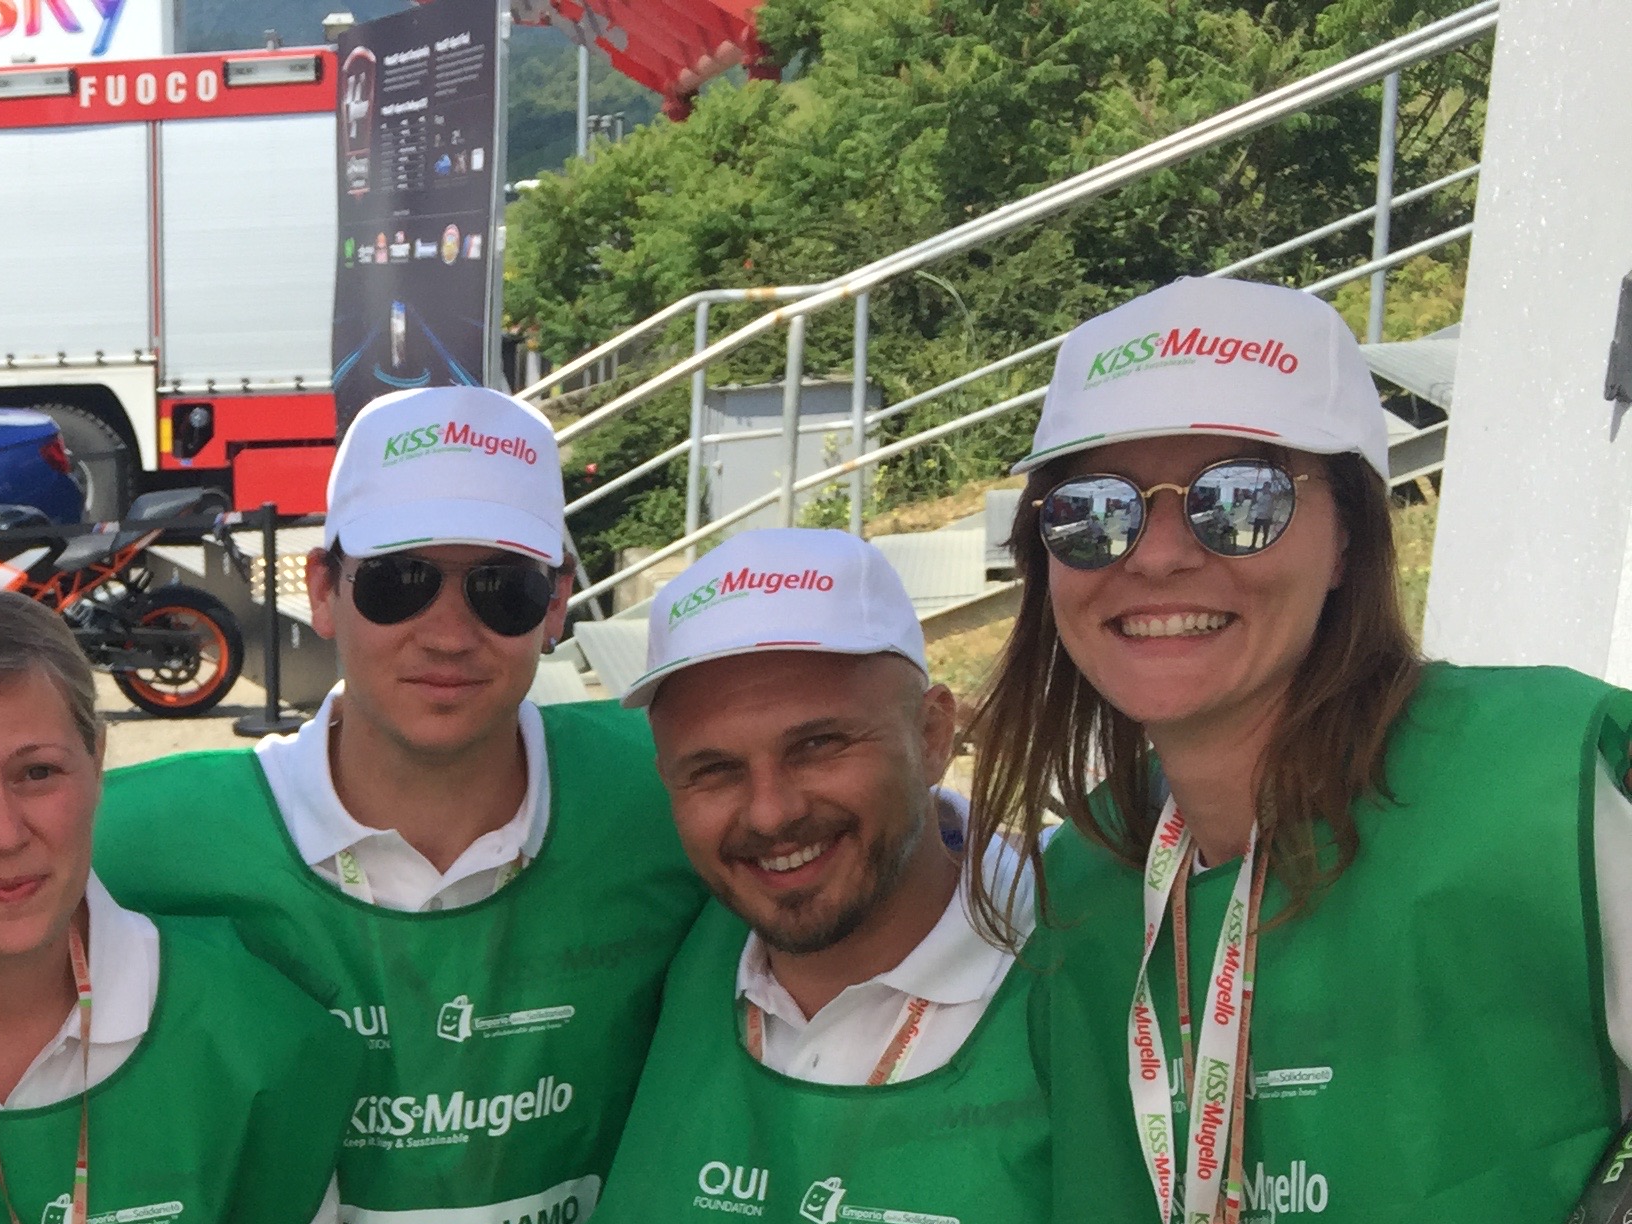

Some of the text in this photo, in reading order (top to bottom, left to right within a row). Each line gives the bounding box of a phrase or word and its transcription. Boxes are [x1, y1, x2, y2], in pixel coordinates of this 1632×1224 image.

[79, 69, 218, 107] FUOCO
[698, 1160, 769, 1202] QUI
[693, 1195, 764, 1217] FOUNDATION
